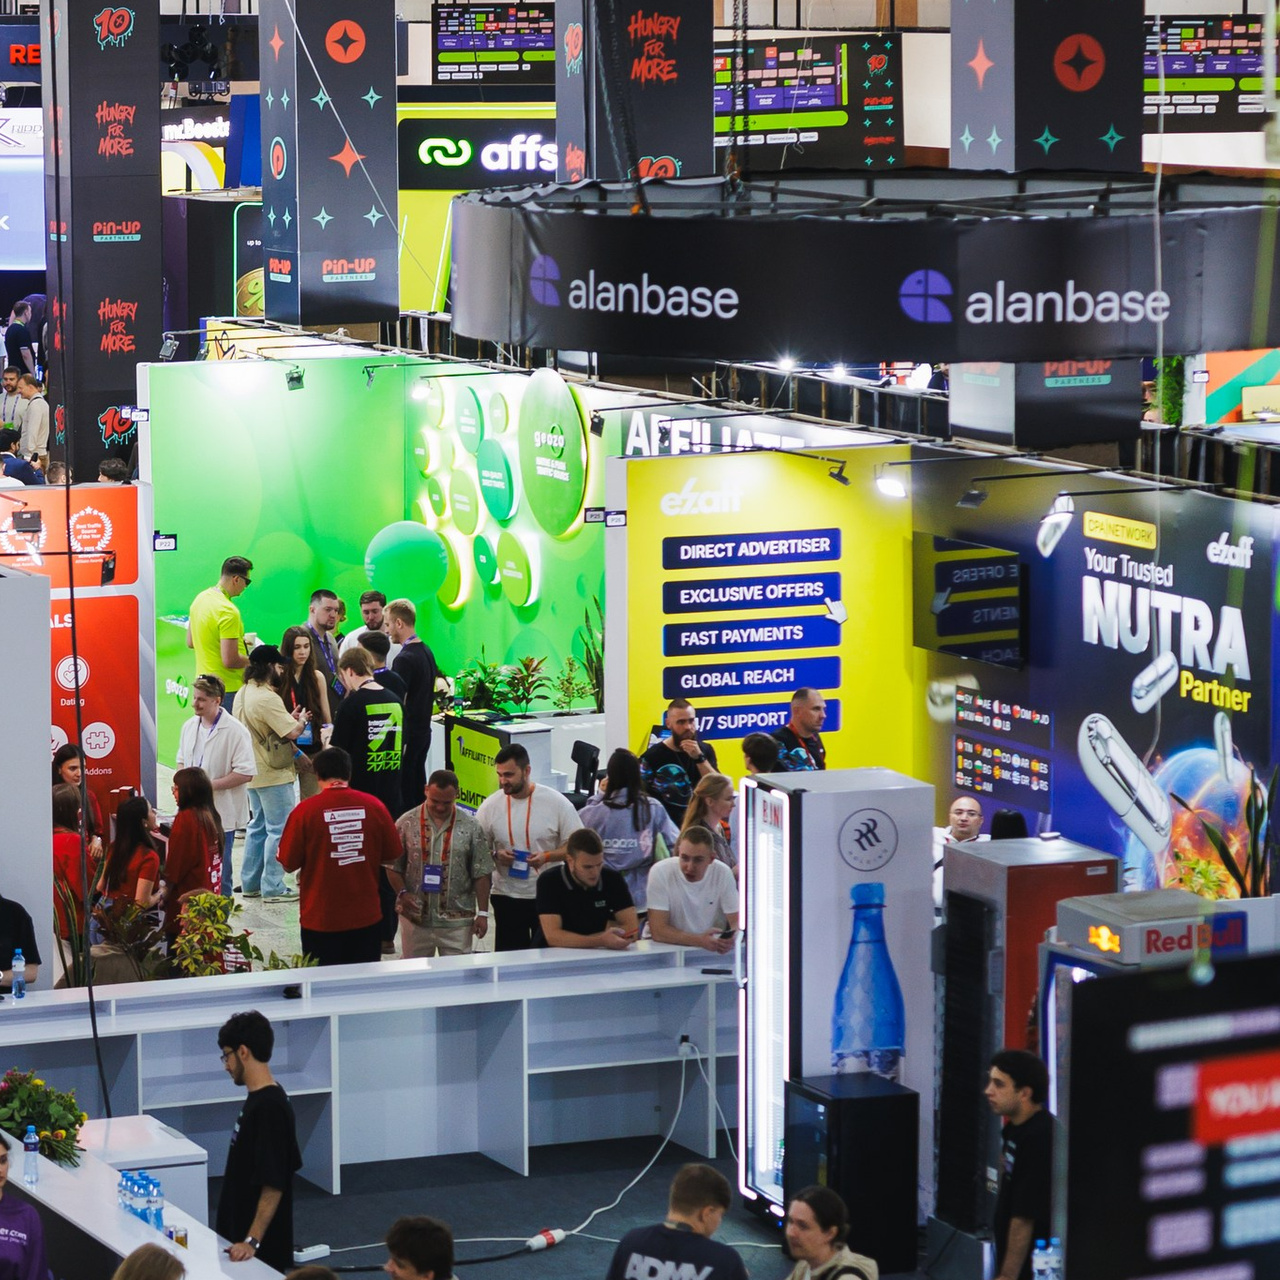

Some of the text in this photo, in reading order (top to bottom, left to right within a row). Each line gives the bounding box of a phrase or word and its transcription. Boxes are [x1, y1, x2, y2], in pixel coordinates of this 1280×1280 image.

[95, 8, 133, 41] 10
[628, 11, 681, 41] HUNGRY
[644, 39, 664, 58] FOR
[630, 58, 678, 82] MORE
[96, 101, 136, 125] HUNGRY
[107, 124, 125, 137] FOR
[98, 138, 134, 158] MORE
[481, 134, 558, 170] affs
[568, 269, 739, 319] alanbase
[966, 280, 1170, 324] alanbase
[98, 297, 138, 321] HUNGRY
[110, 322, 125, 335] FOR
[100, 335, 136, 356] MORE
[680, 538, 831, 560] DIRECT ADVERTISER
[1085, 547, 1173, 587] Your Trusted
[680, 582, 824, 604] EXCLUSIVE OFFERS
[681, 625, 804, 646] FAST PAYMENTS
[1082, 576, 1252, 681] NUTRA
[680, 668, 795, 689] GLOBAL REACH
[1180, 670, 1252, 713] Partner
[718, 711, 789, 730] SUPPORT
[1147, 925, 1192, 954] Red
